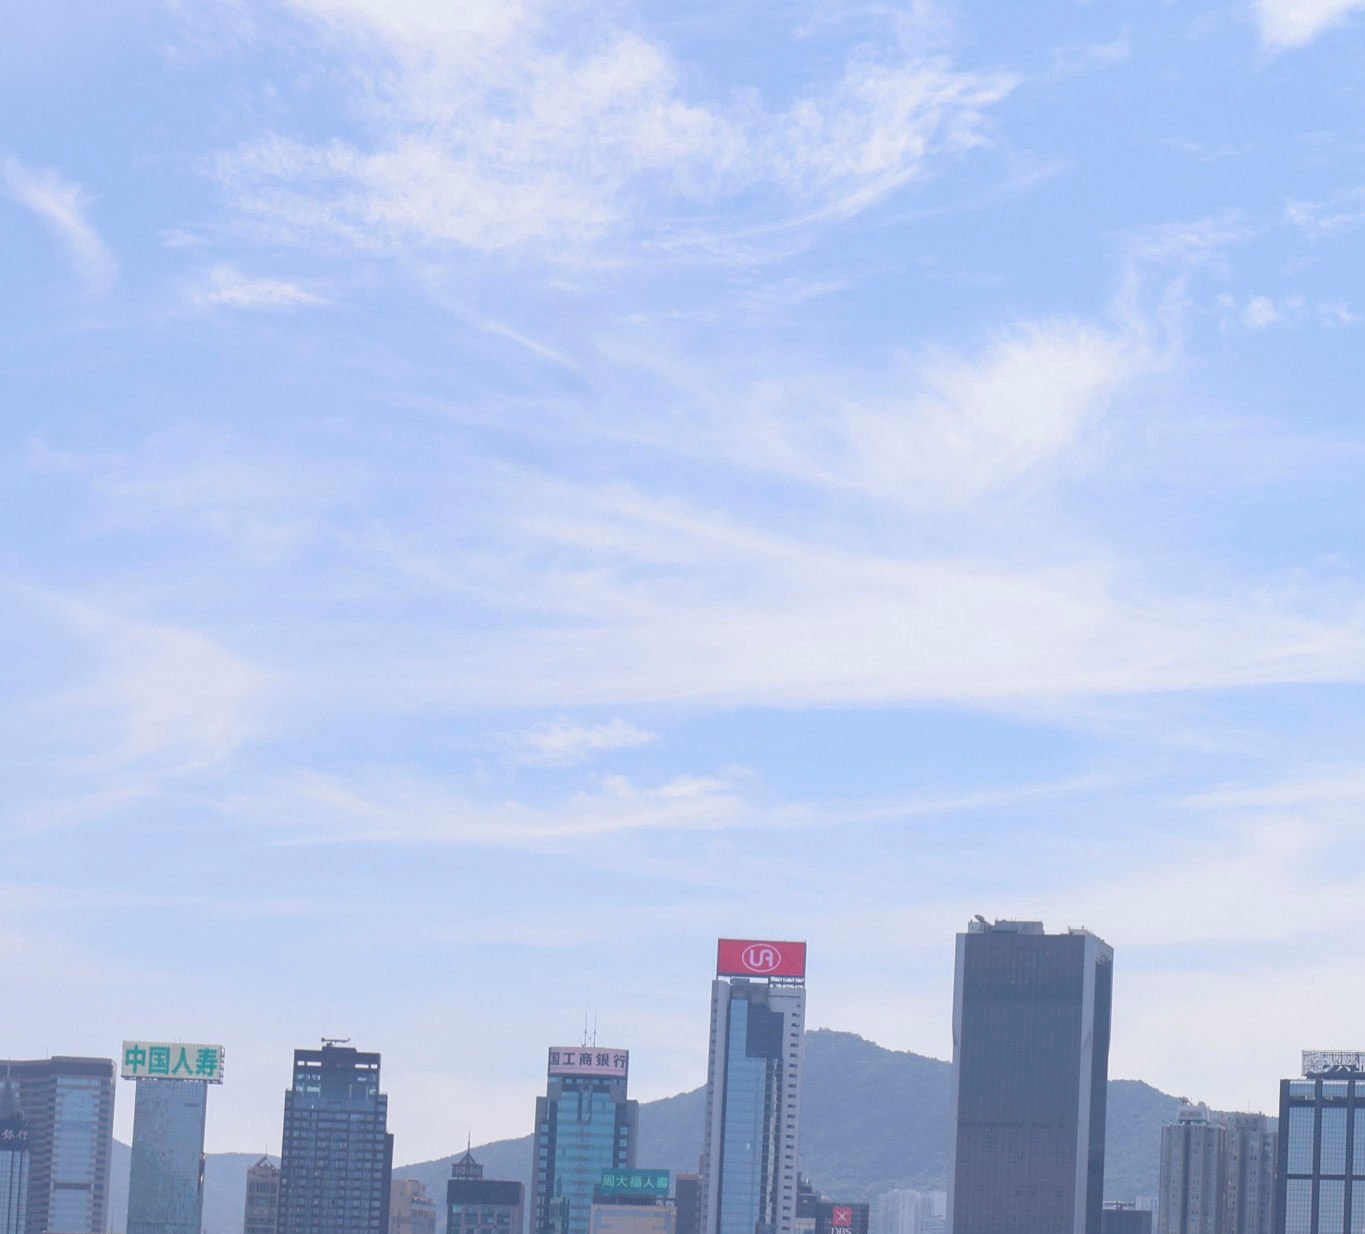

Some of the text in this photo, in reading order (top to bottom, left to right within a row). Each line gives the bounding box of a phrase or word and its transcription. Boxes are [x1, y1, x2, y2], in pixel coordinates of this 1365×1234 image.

[124, 1043, 219, 1077] 中国人寿
[602, 1175, 670, 1189] 周大福人壽
